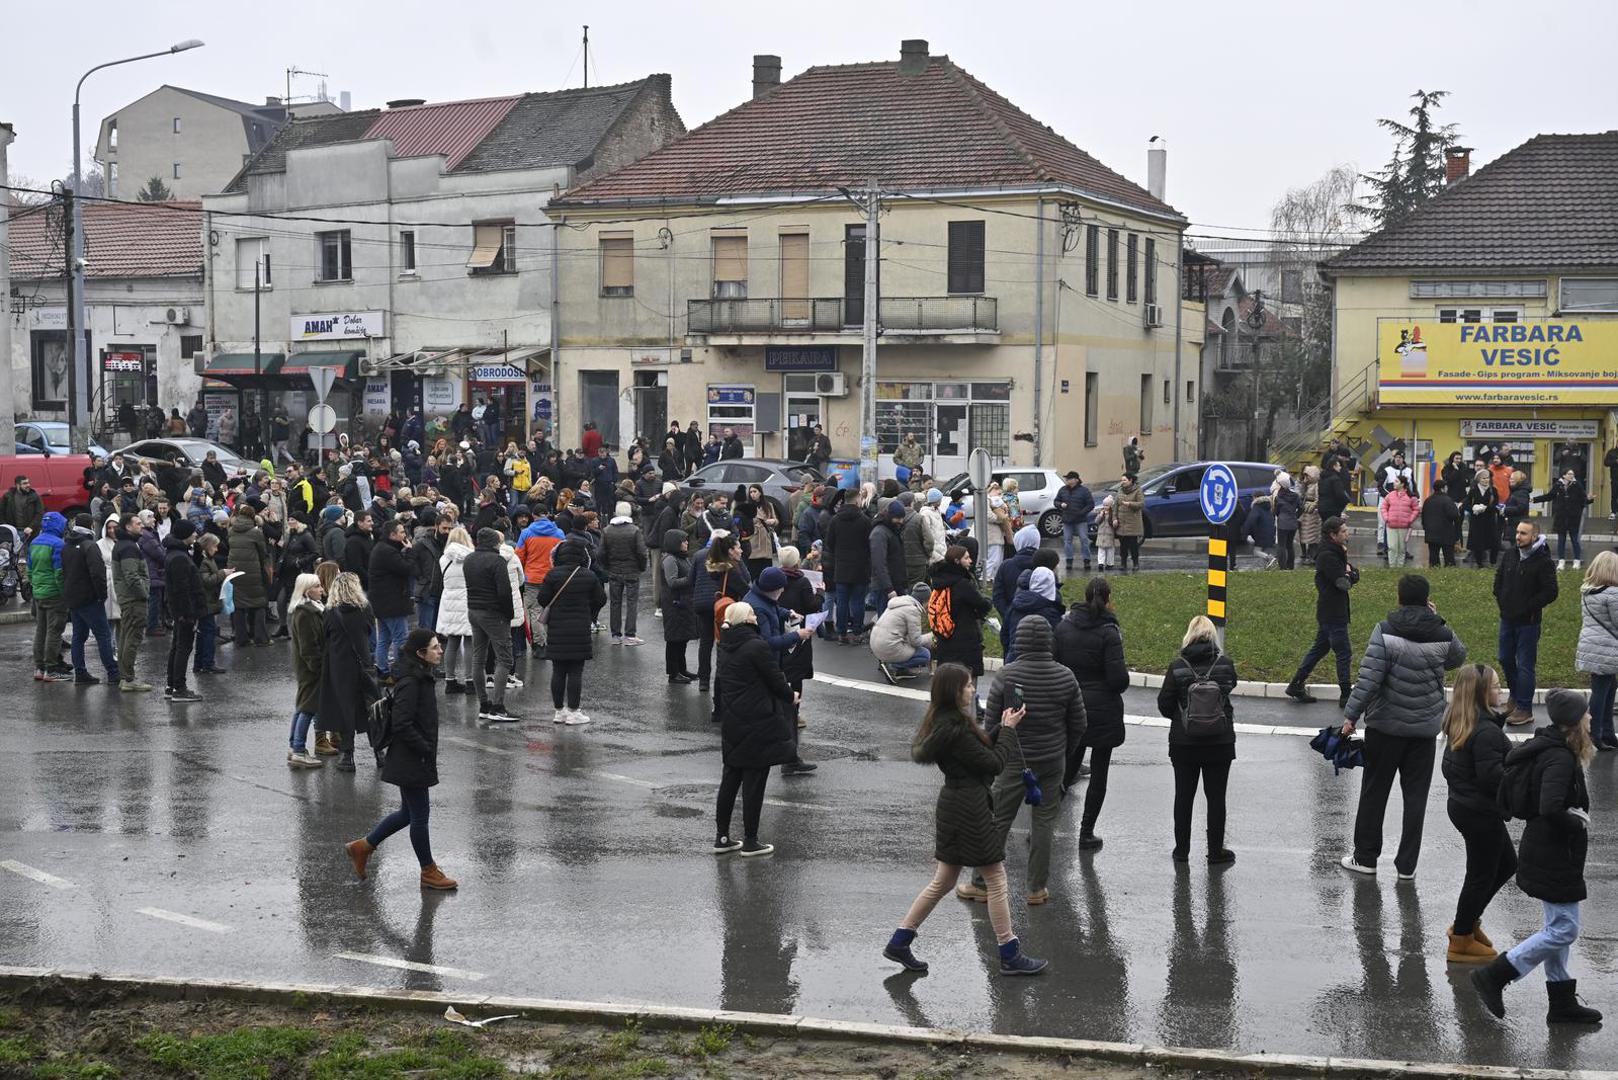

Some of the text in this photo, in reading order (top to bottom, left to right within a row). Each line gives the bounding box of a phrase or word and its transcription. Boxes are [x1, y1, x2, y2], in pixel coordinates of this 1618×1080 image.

[1460, 325, 1583, 343] FARBARA
[768, 351, 832, 365] PEKARA
[1480, 344, 1560, 366] VESIĆ
[1438, 370, 1471, 378] Fasade
[1477, 370, 1498, 379] Gips
[1501, 371, 1540, 379] program
[1547, 370, 1600, 379] Miksovanje
[1602, 370, 1617, 379] boj
[1455, 393, 1559, 401] www.farbaravesic.rs
[1475, 421, 1557, 430] FARBARA VESIĆ
